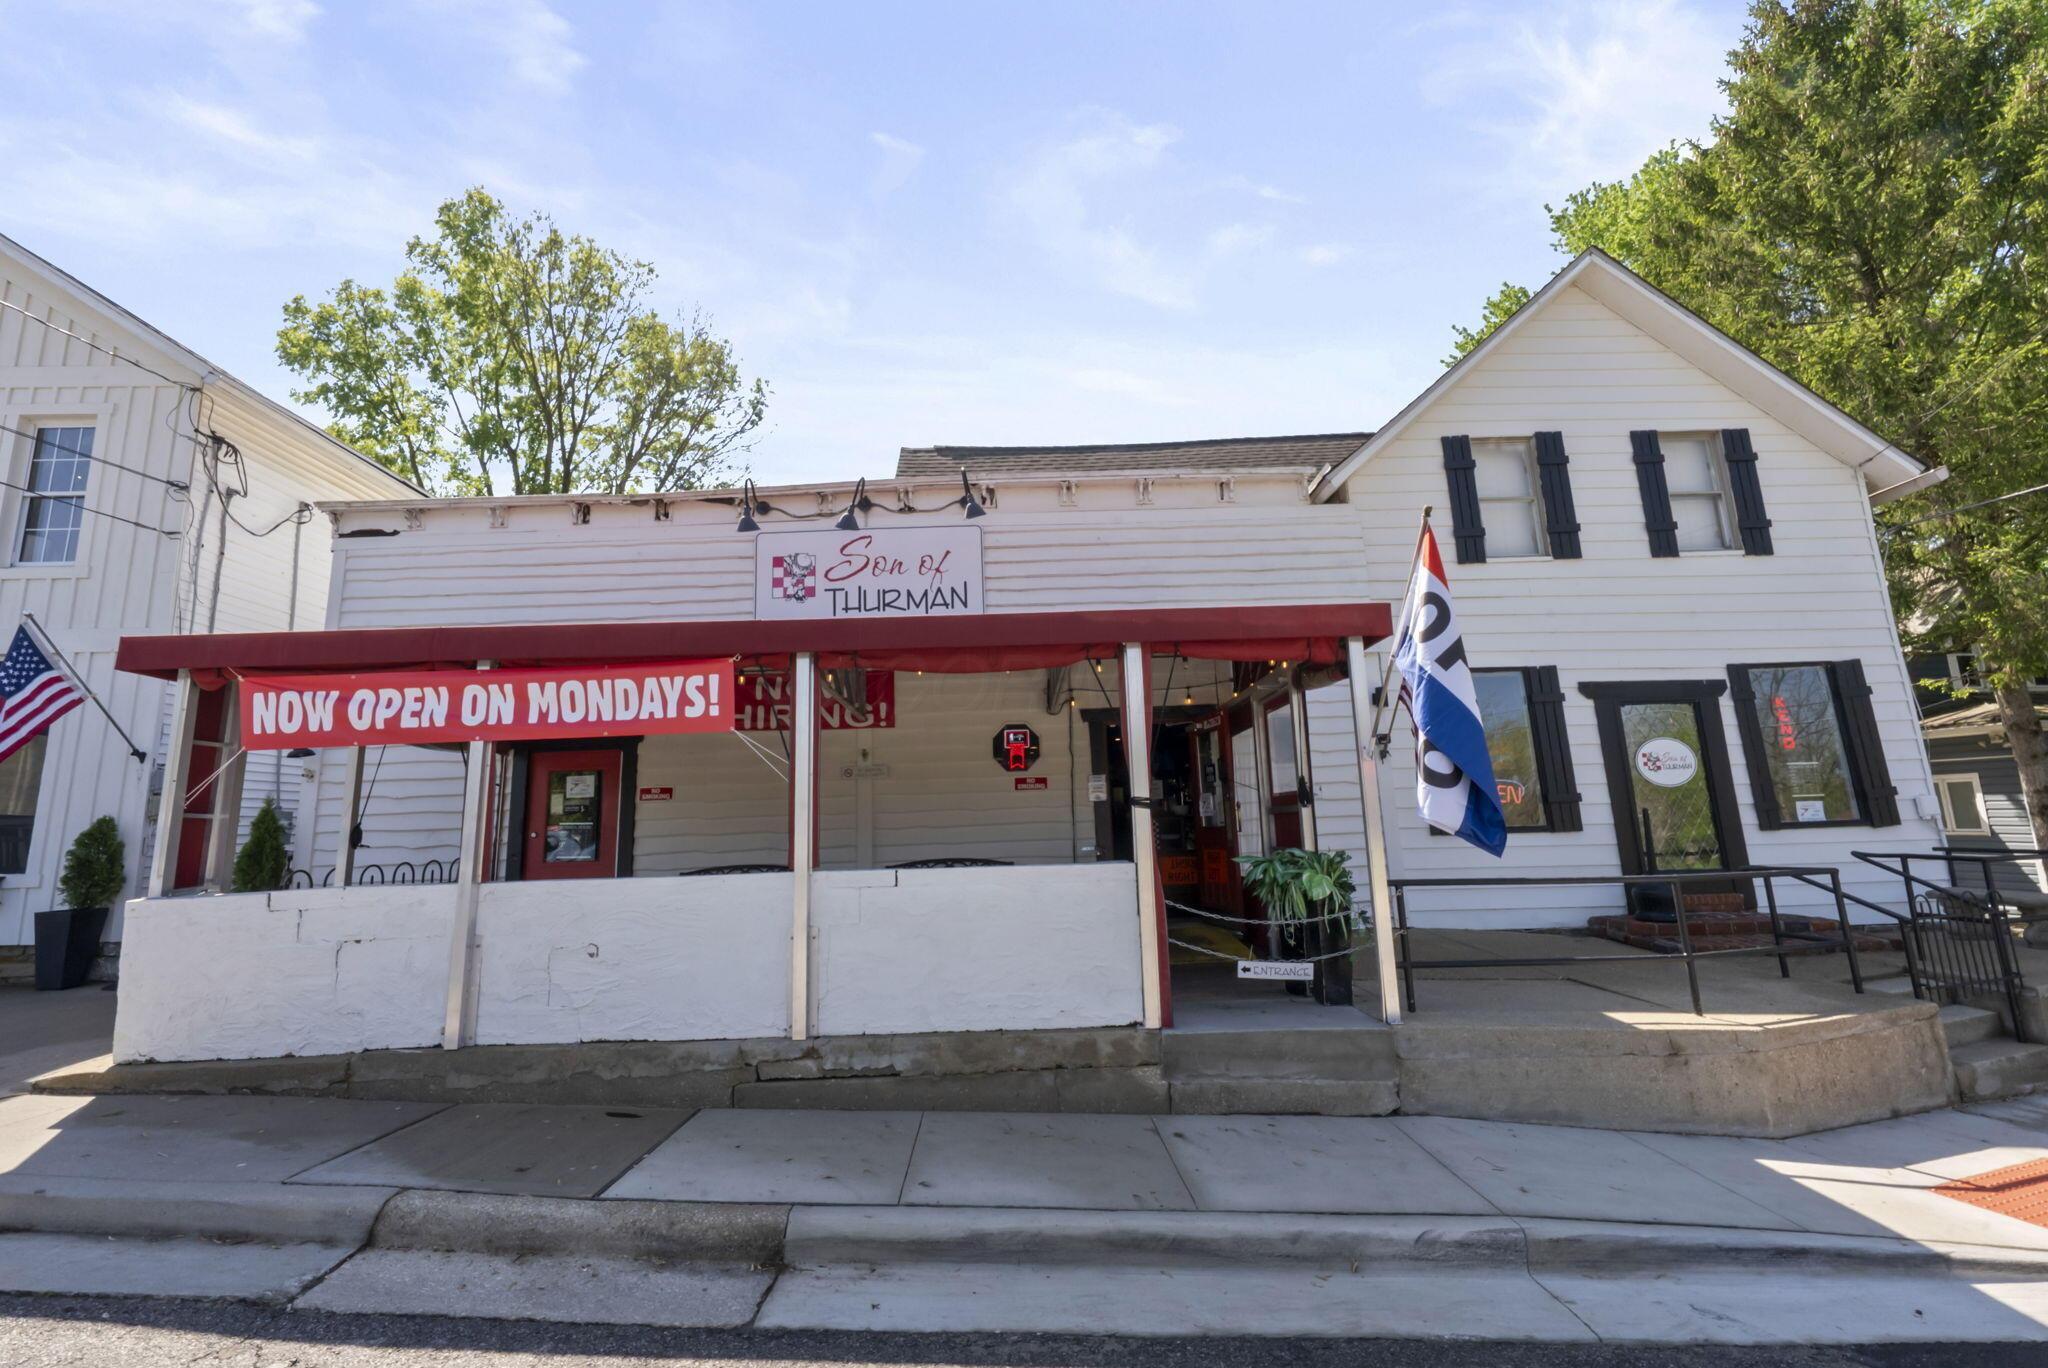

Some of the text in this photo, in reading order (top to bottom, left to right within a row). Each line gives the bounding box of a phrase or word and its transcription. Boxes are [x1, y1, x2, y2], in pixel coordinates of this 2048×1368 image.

[824, 535, 952, 592] Son of
[824, 581, 968, 617] THURMAN
[253, 673, 720, 735] NOW OPEN ON MONDAYS!
[735, 702, 887, 729] HIRNG!
[1253, 966, 1311, 977] ENTRANCE
